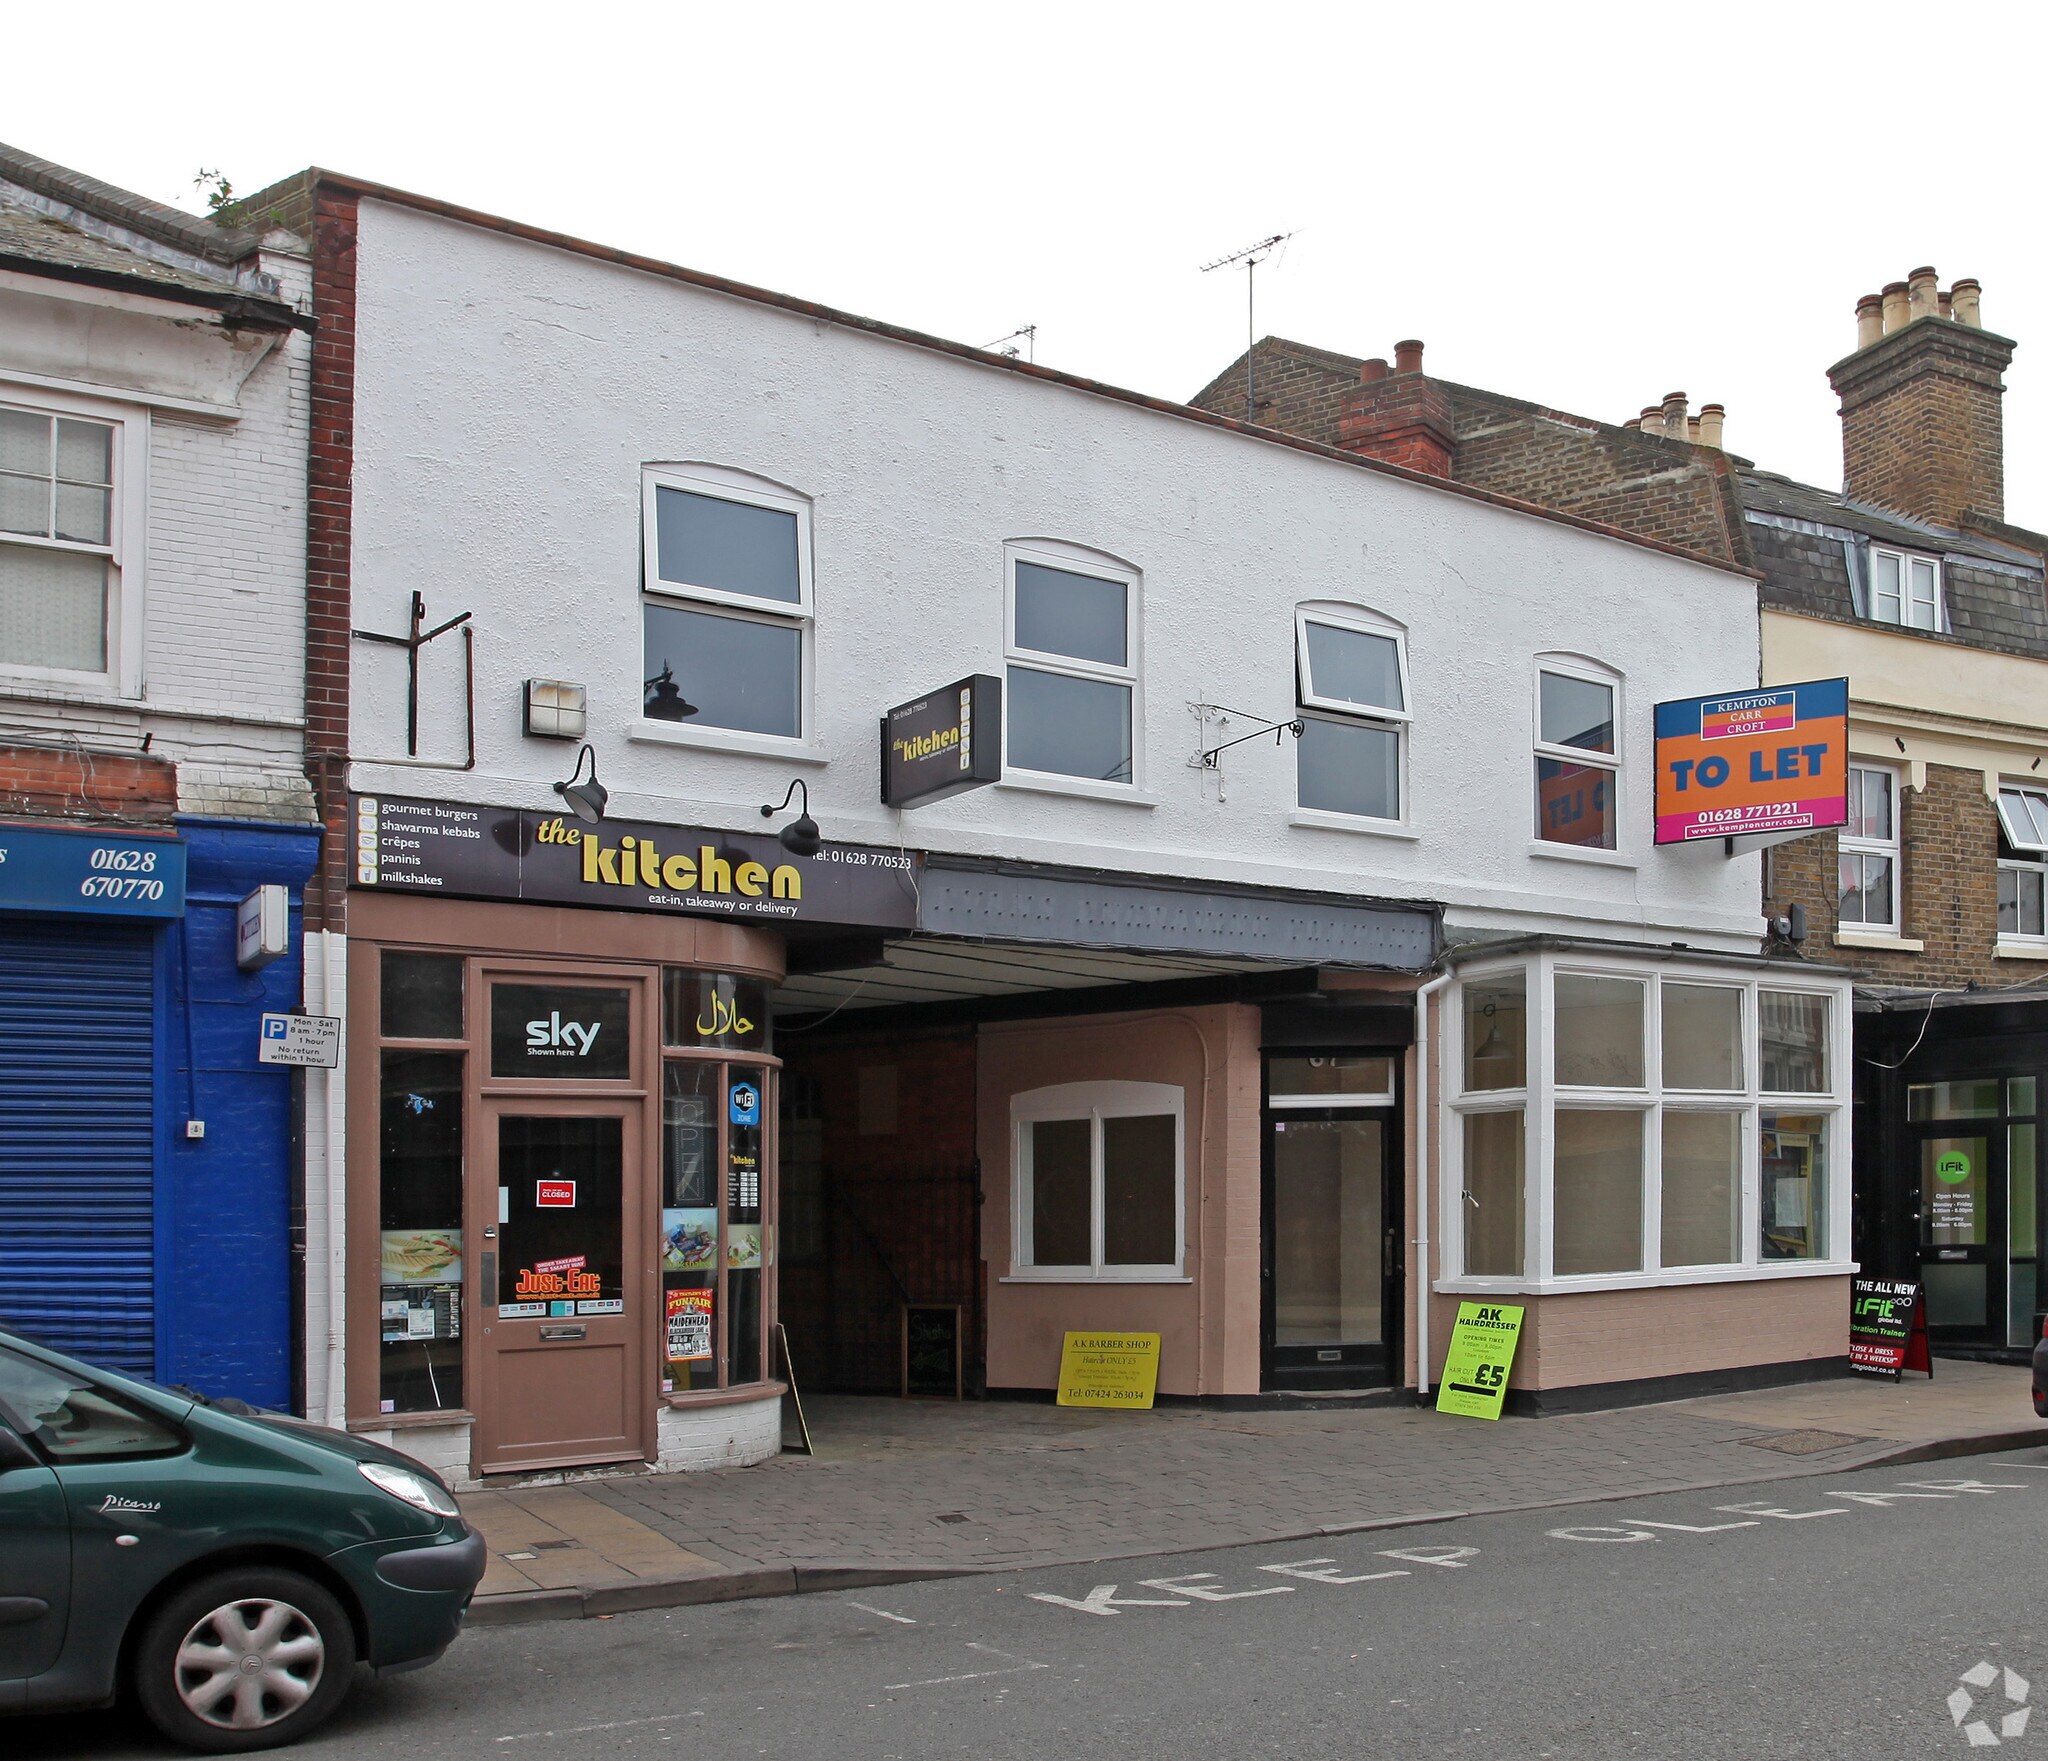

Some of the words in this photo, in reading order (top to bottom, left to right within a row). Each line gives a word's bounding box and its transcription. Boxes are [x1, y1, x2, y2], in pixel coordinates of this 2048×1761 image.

[1717, 696, 1777, 713] KEMPTON
[1730, 710, 1763, 722] CARR
[1727, 721, 1767, 734] CROFT
[903, 727, 959, 762] kitchen
[1670, 755, 1730, 792] TO
[1750, 743, 1828, 783] LET
[381, 803, 432, 816] gourmet
[435, 806, 479, 821] burgers
[1698, 808, 1742, 824] 01628
[1745, 802, 1798, 819] 771221
[381, 820, 439, 835] shawarma
[442, 826, 481, 839] kebabs
[537, 817, 581, 845] the
[1691, 816, 1809, 835] www.kemptoncarr.co.uk
[381, 836, 421, 849] crêpes
[90, 848, 157, 873] 01628
[381, 853, 421, 865] paninis
[583, 833, 802, 900] kitchen
[812, 850, 829, 862] el:
[832, 850, 867, 865] 01628
[871, 855, 911, 870] 770523
[381, 871, 443, 886] milkshakes
[80, 875, 164, 900] 670770
[648, 895, 684, 907] eat-in,
[686, 896, 736, 912] takeaway
[739, 902, 752, 911] or
[755, 901, 798, 917] delivery
[293, 1018, 312, 1026] Mon
[526, 1011, 601, 1056] sky
[293, 1047, 320, 1055] return
[527, 1047, 555, 1056] Shown
[556, 1048, 575, 1056] here
[737, 1114, 752, 1122] ZONE
[555, 1256, 585, 1266] TAKEAWAY
[1856, 1280, 1874, 1292] THE
[1874, 1281, 1892, 1294] ALL
[1893, 1283, 1917, 1295] NEW
[669, 1315, 709, 1327] MAIDENHEAD
[1477, 1307, 1503, 1321] AK
[1459, 1318, 1517, 1331] HAIRDRESSER
[1463, 1334, 1487, 1342] OPENING
[1880, 1327, 1906, 1338] Trainer
[1072, 1339, 1088, 1348] A.K
[1089, 1340, 1123, 1349] BARBER
[1126, 1341, 1151, 1349] SHOP
[1874, 1348, 1894, 1356] DRESS
[1474, 1363, 1505, 1387] £5
[1068, 1388, 1083, 1398] Tel:
[1085, 1389, 1110, 1399] 07424
[1113, 1390, 1144, 1400] 263034
[99, 1494, 161, 1513] Picasso
[1544, 1478, 2030, 1543] CLEAR
[1024, 1545, 1481, 1616] KEEP
